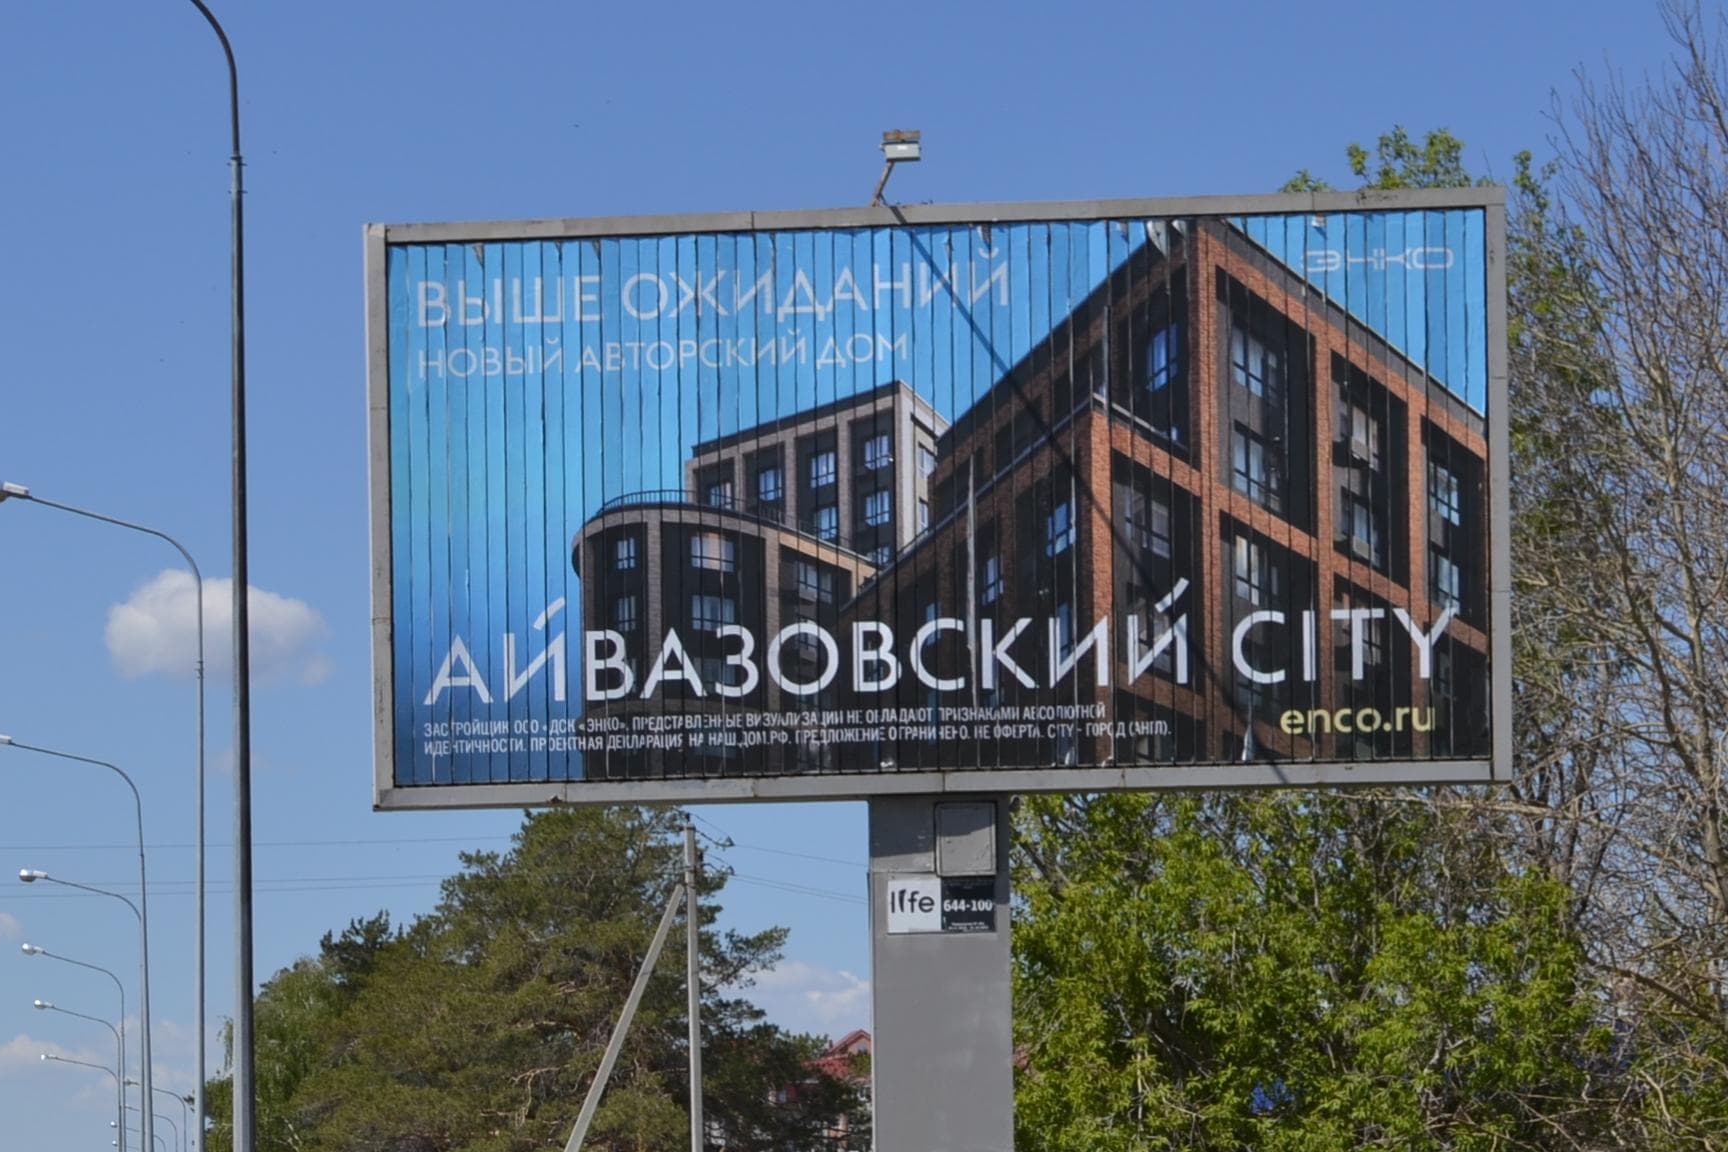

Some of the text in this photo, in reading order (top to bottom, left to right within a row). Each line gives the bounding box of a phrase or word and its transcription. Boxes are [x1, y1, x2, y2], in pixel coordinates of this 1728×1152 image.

[417, 246, 1008, 328] ВЫШЕ ОЖИДАНИЙ
[419, 329, 908, 379] НОВЫЙ АВТОРСКИЙ ДОМ
[423, 578, 1460, 705] АЙВАЗОВСКИЙ CITY
[424, 719, 509, 737] ЗАСТРОЙЩИК
[847, 709, 863, 725] НЕ
[689, 732, 703, 747] НА
[1280, 706, 1436, 734] enco.ru
